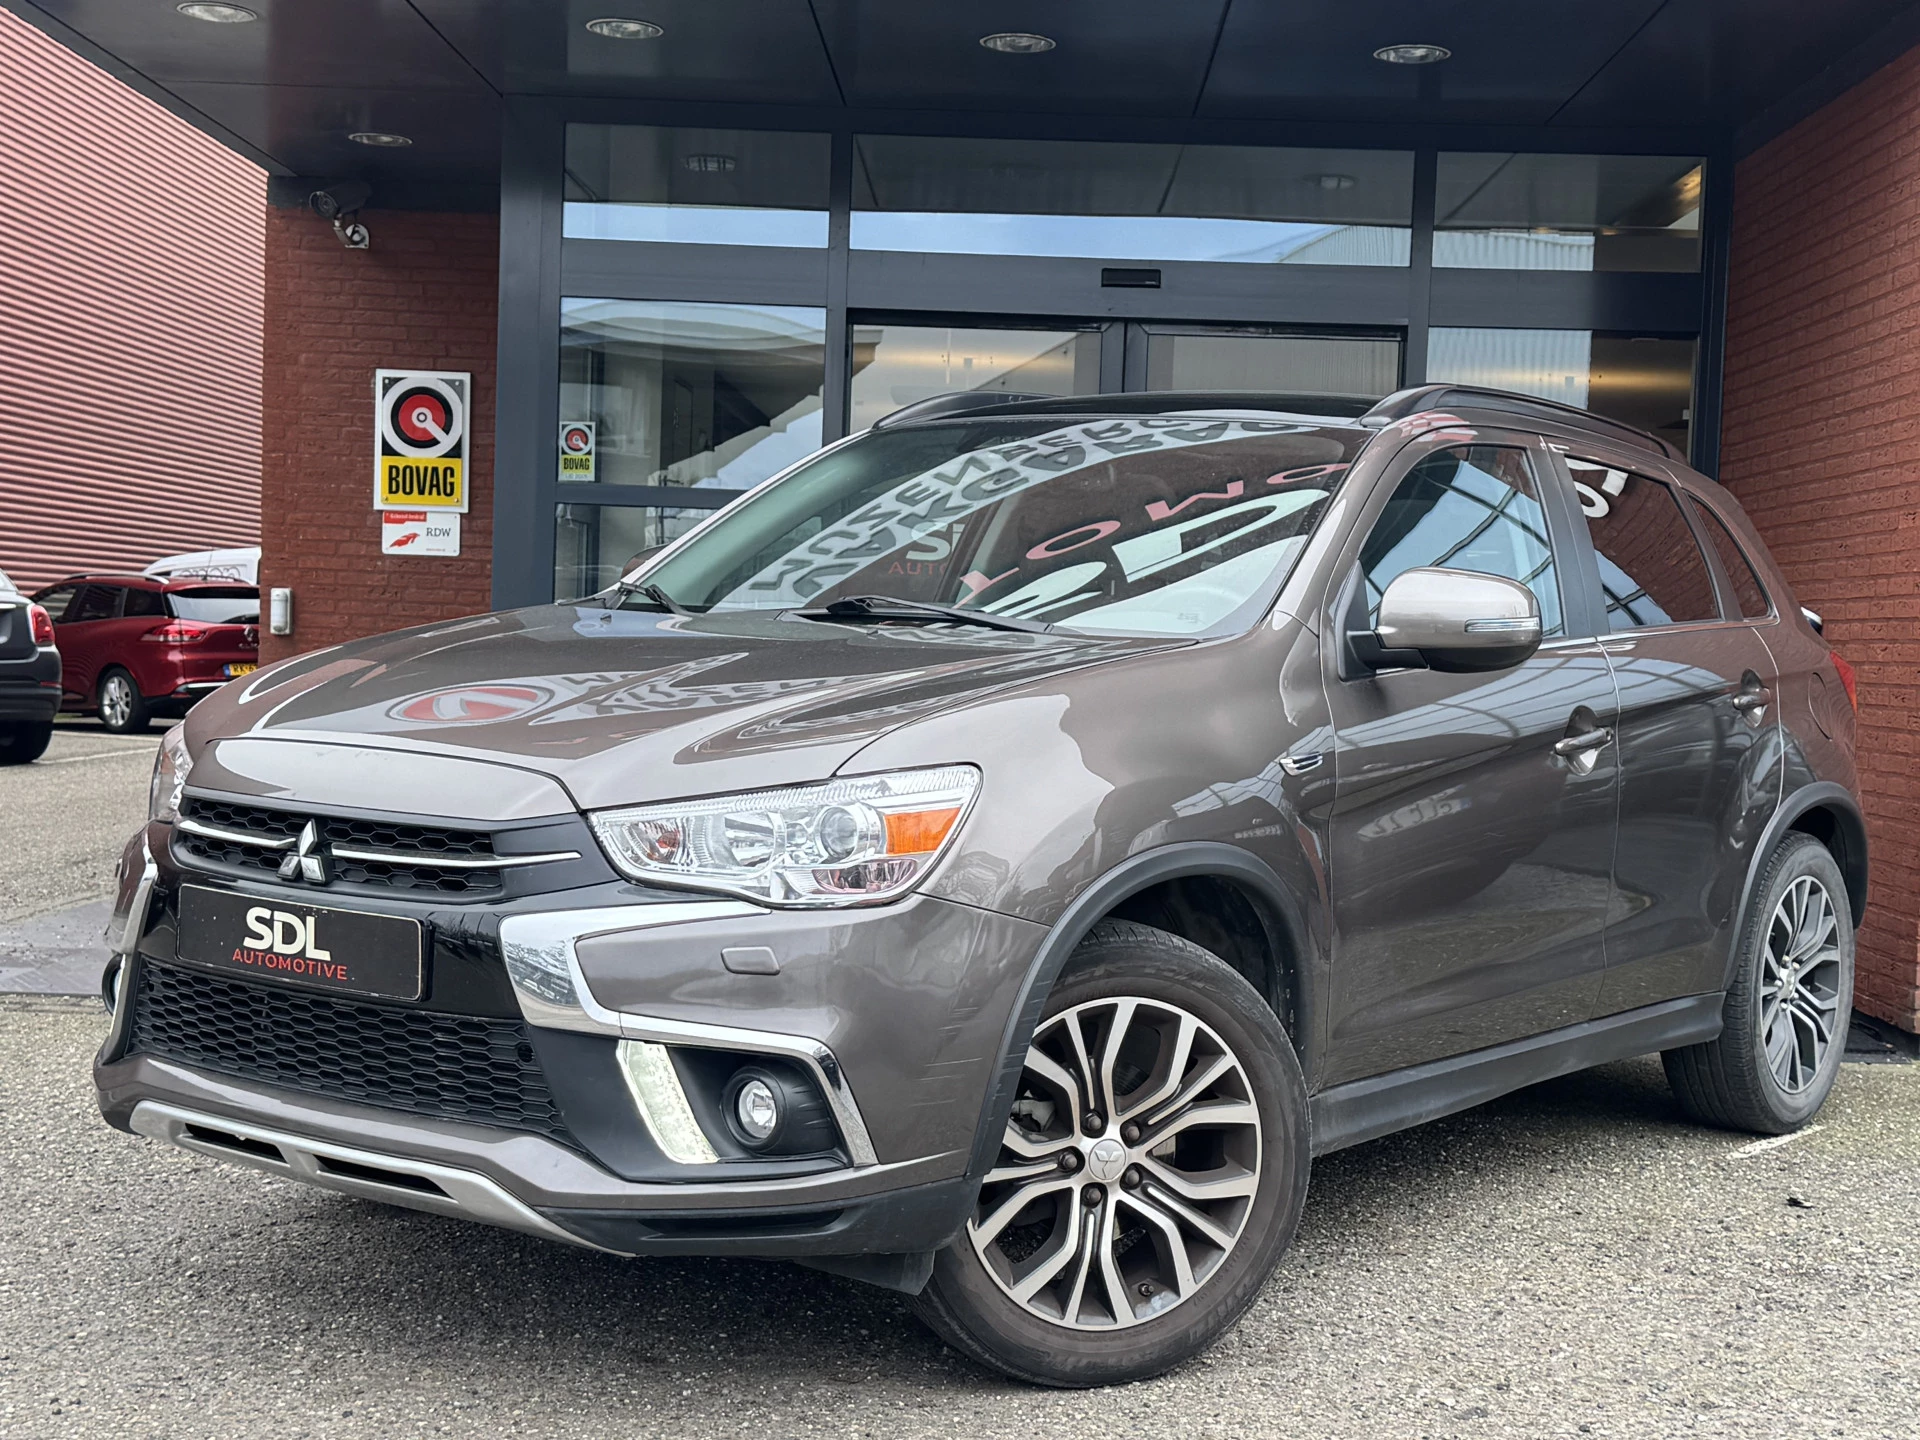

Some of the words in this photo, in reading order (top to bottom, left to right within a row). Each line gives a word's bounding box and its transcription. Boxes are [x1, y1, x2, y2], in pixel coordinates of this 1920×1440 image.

[564, 457, 590, 471] BOVAG
[388, 465, 455, 497] BOVAG
[426, 527, 451, 537] RDW
[243, 906, 331, 961] SDL
[232, 948, 348, 981] AUTOMOTIVE
